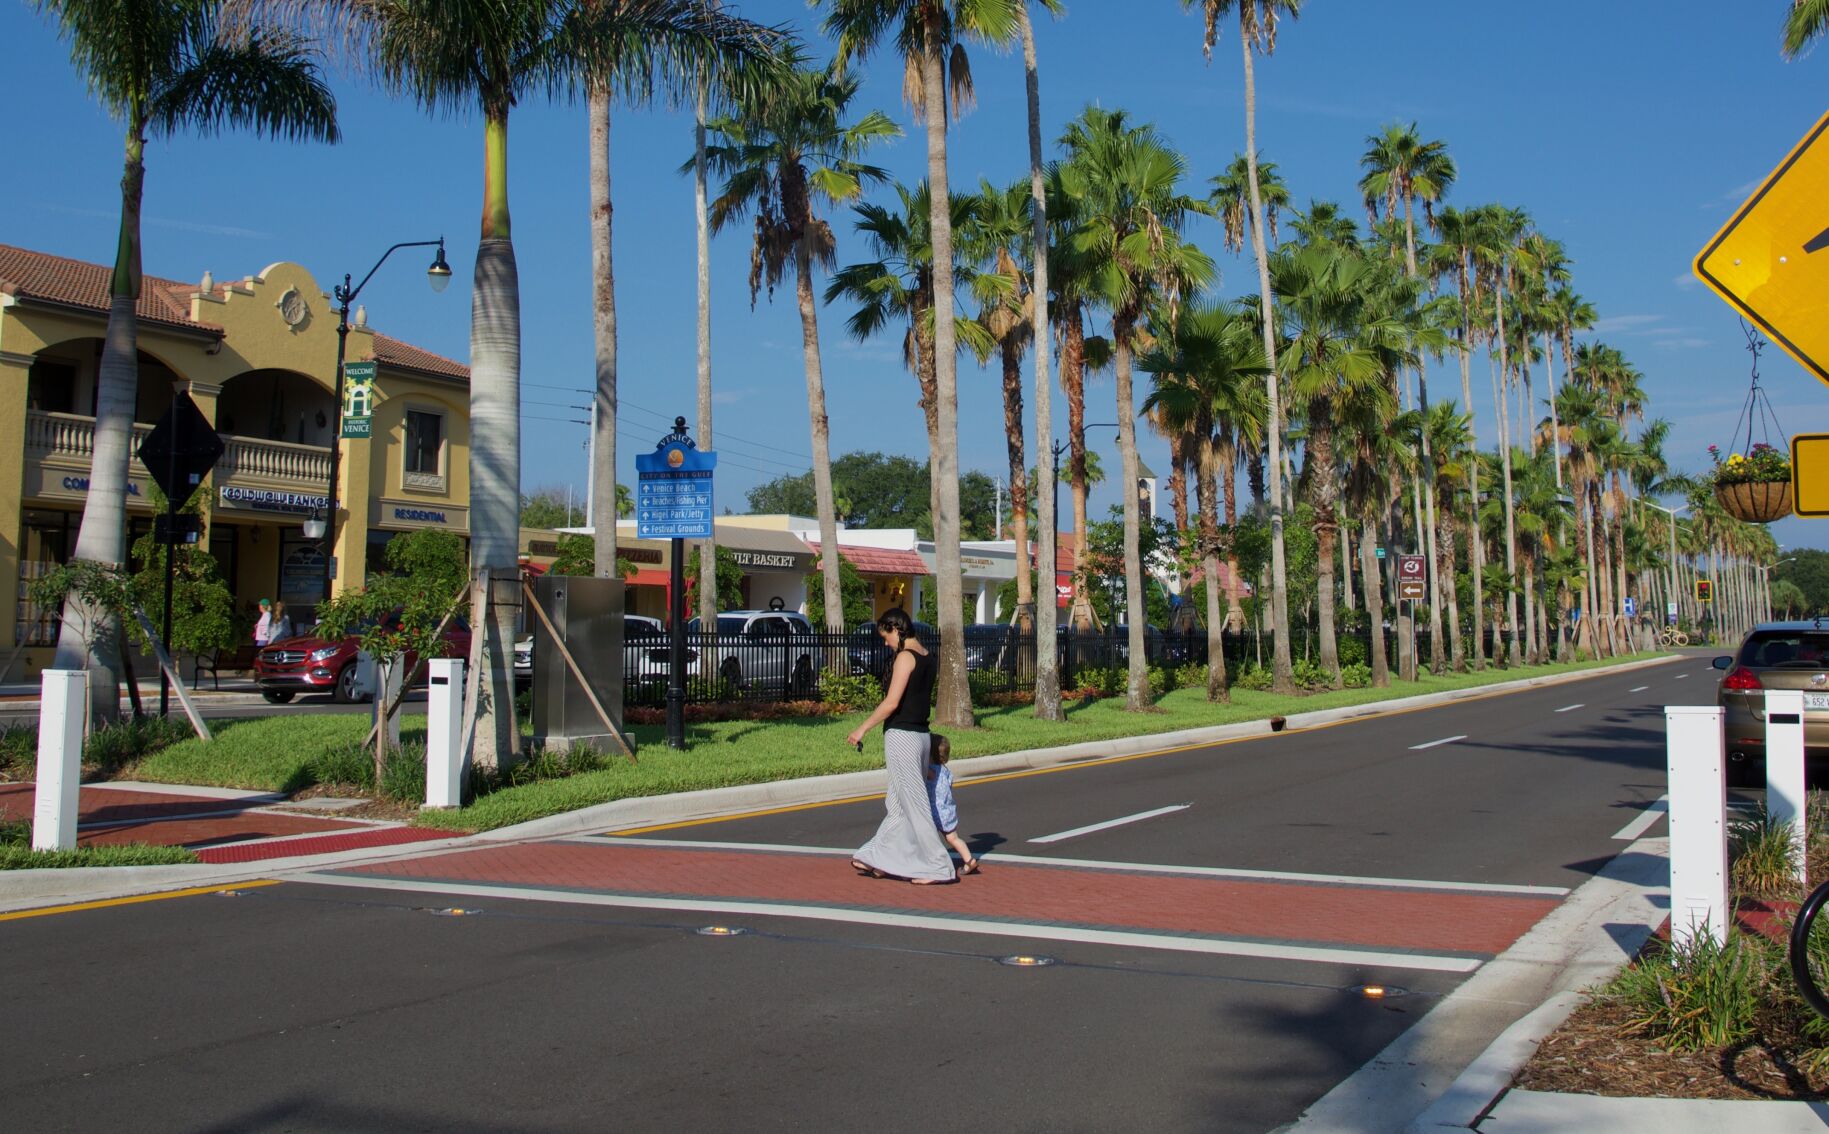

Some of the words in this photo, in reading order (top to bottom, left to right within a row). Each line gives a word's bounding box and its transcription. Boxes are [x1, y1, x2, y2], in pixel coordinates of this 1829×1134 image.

[346, 367, 374, 375] WELCOME
[344, 424, 370, 433] VENICE
[660, 434, 692, 447] VENICE
[652, 484, 674, 493] Venice
[676, 484, 696, 492] Beach
[696, 495, 708, 505] Pier
[651, 524, 676, 534] Festival
[677, 523, 705, 533] Grounds
[753, 553, 795, 567] BASKET
